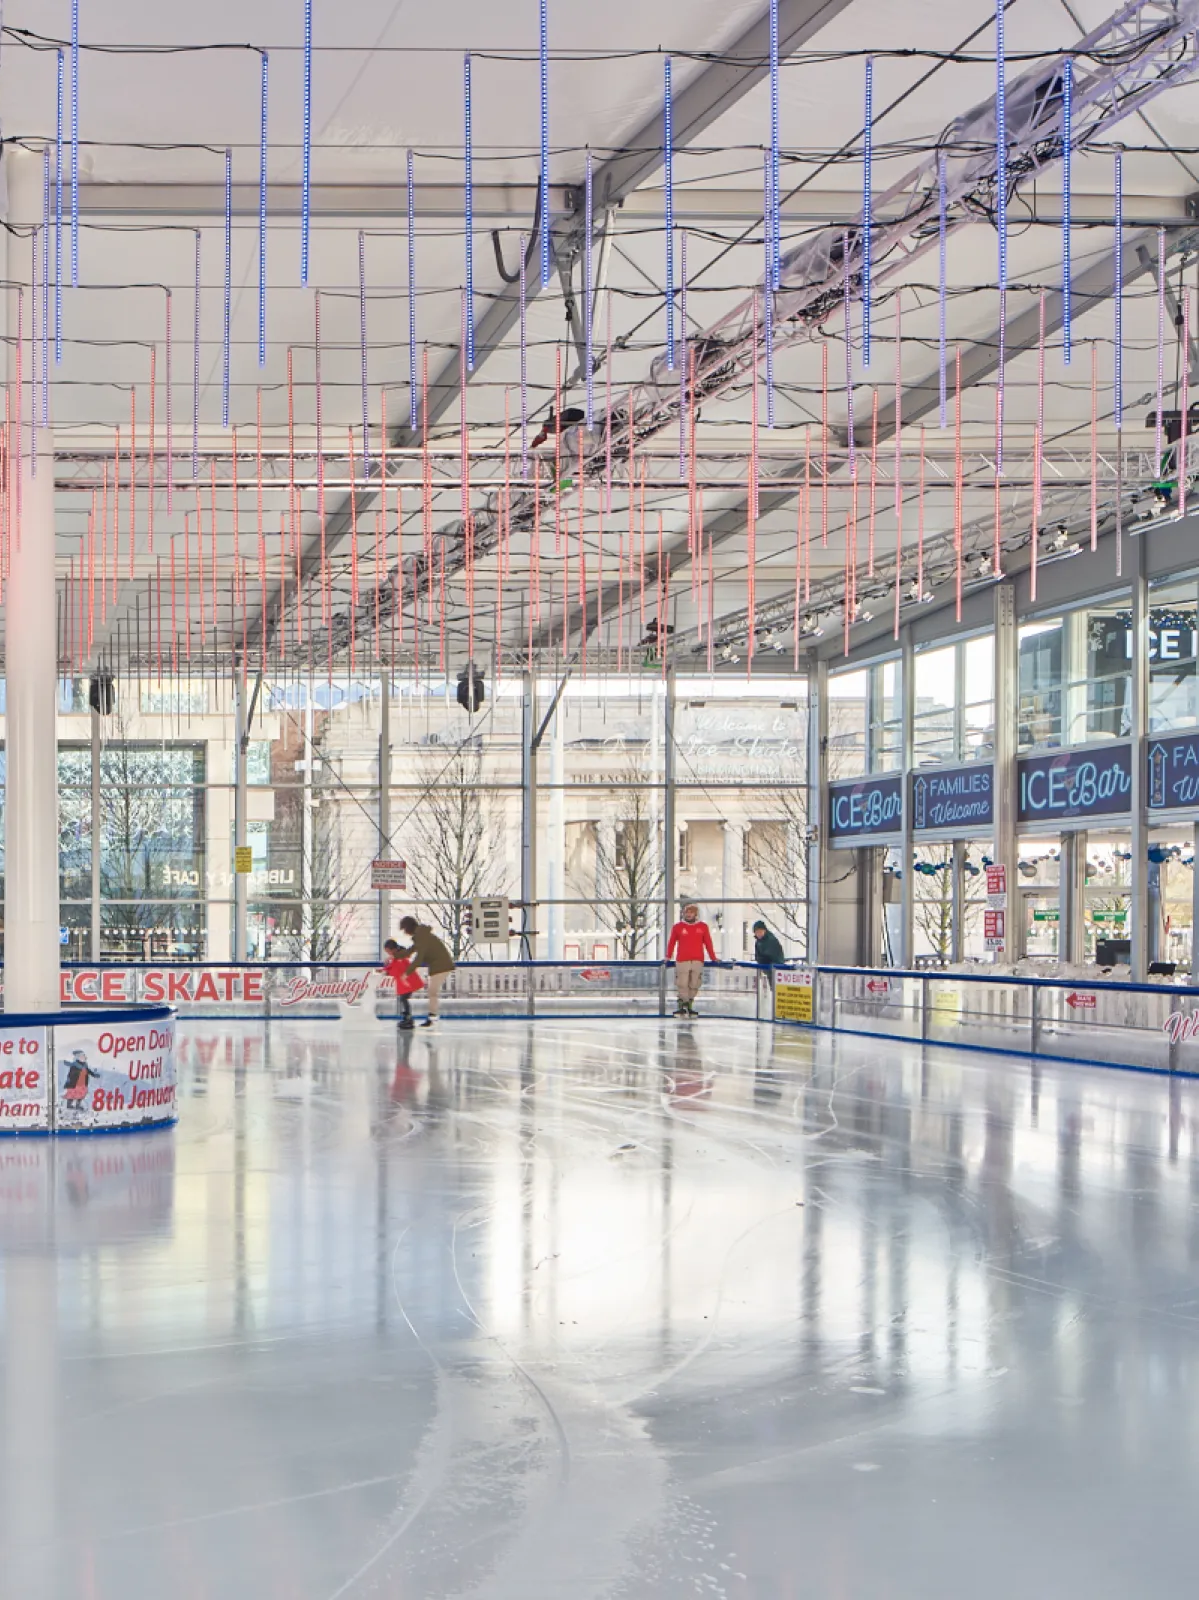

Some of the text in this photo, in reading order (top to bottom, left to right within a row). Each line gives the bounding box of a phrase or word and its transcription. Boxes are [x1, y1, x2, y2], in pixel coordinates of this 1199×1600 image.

[571, 774, 595, 784] THE
[600, 773, 665, 784] EXCHANE
[930, 773, 990, 797] FAMILIES
[1021, 766, 1067, 811] ICE
[1069, 762, 1131, 806] Bar
[832, 789, 902, 829] ICE Bar
[930, 800, 990, 825] Welcome
[60, 972, 263, 1001] ICE SKATE
[281, 971, 395, 1005] Birminghm
[18, 1037, 39, 1055] to
[97, 1028, 174, 1058] Open Daily
[128, 1056, 163, 1081] Until
[92, 1088, 125, 1112] 8th
